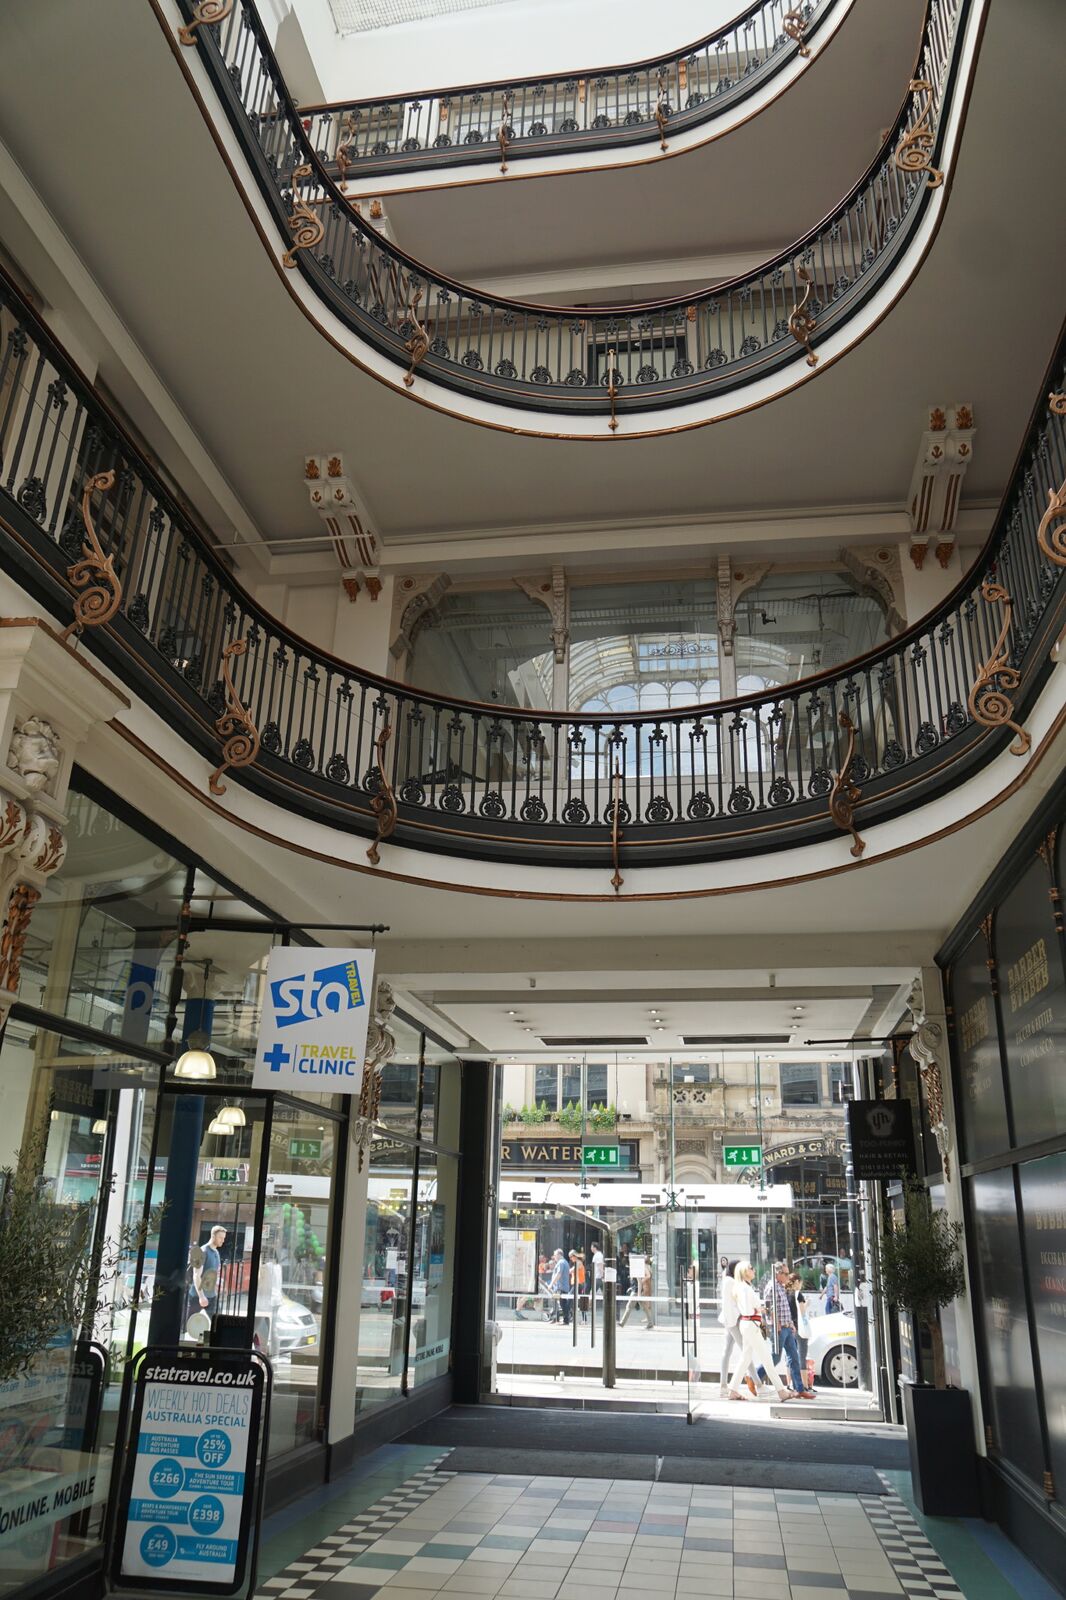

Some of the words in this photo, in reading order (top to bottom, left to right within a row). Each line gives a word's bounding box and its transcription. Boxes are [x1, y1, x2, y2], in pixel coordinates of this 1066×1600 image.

[1007, 938, 1047, 991] BARBER
[345, 961, 361, 1007] TRAVEL
[273, 971, 349, 1019] sta
[300, 1044, 357, 1060] TRAVEL
[298, 1058, 356, 1076] CLINIC
[145, 1366, 257, 1386] statravel.co.uk
[147, 1388, 189, 1411] WEEKLY
[191, 1391, 213, 1412] HOT
[216, 1393, 249, 1416] DEALS
[145, 1410, 202, 1425] AUSTRALIA
[204, 1414, 247, 1428] SPECIAL
[150, 1435, 178, 1443] AUSTRALIA
[202, 1438, 226, 1450] 25%
[203, 1452, 224, 1464] OFF
[153, 1472, 180, 1484] £266
[53, 1475, 95, 1510] MOBILE
[192, 1508, 220, 1521] £398
[147, 1538, 169, 1551] £49
[198, 1550, 227, 1558] AUSTRALIA
